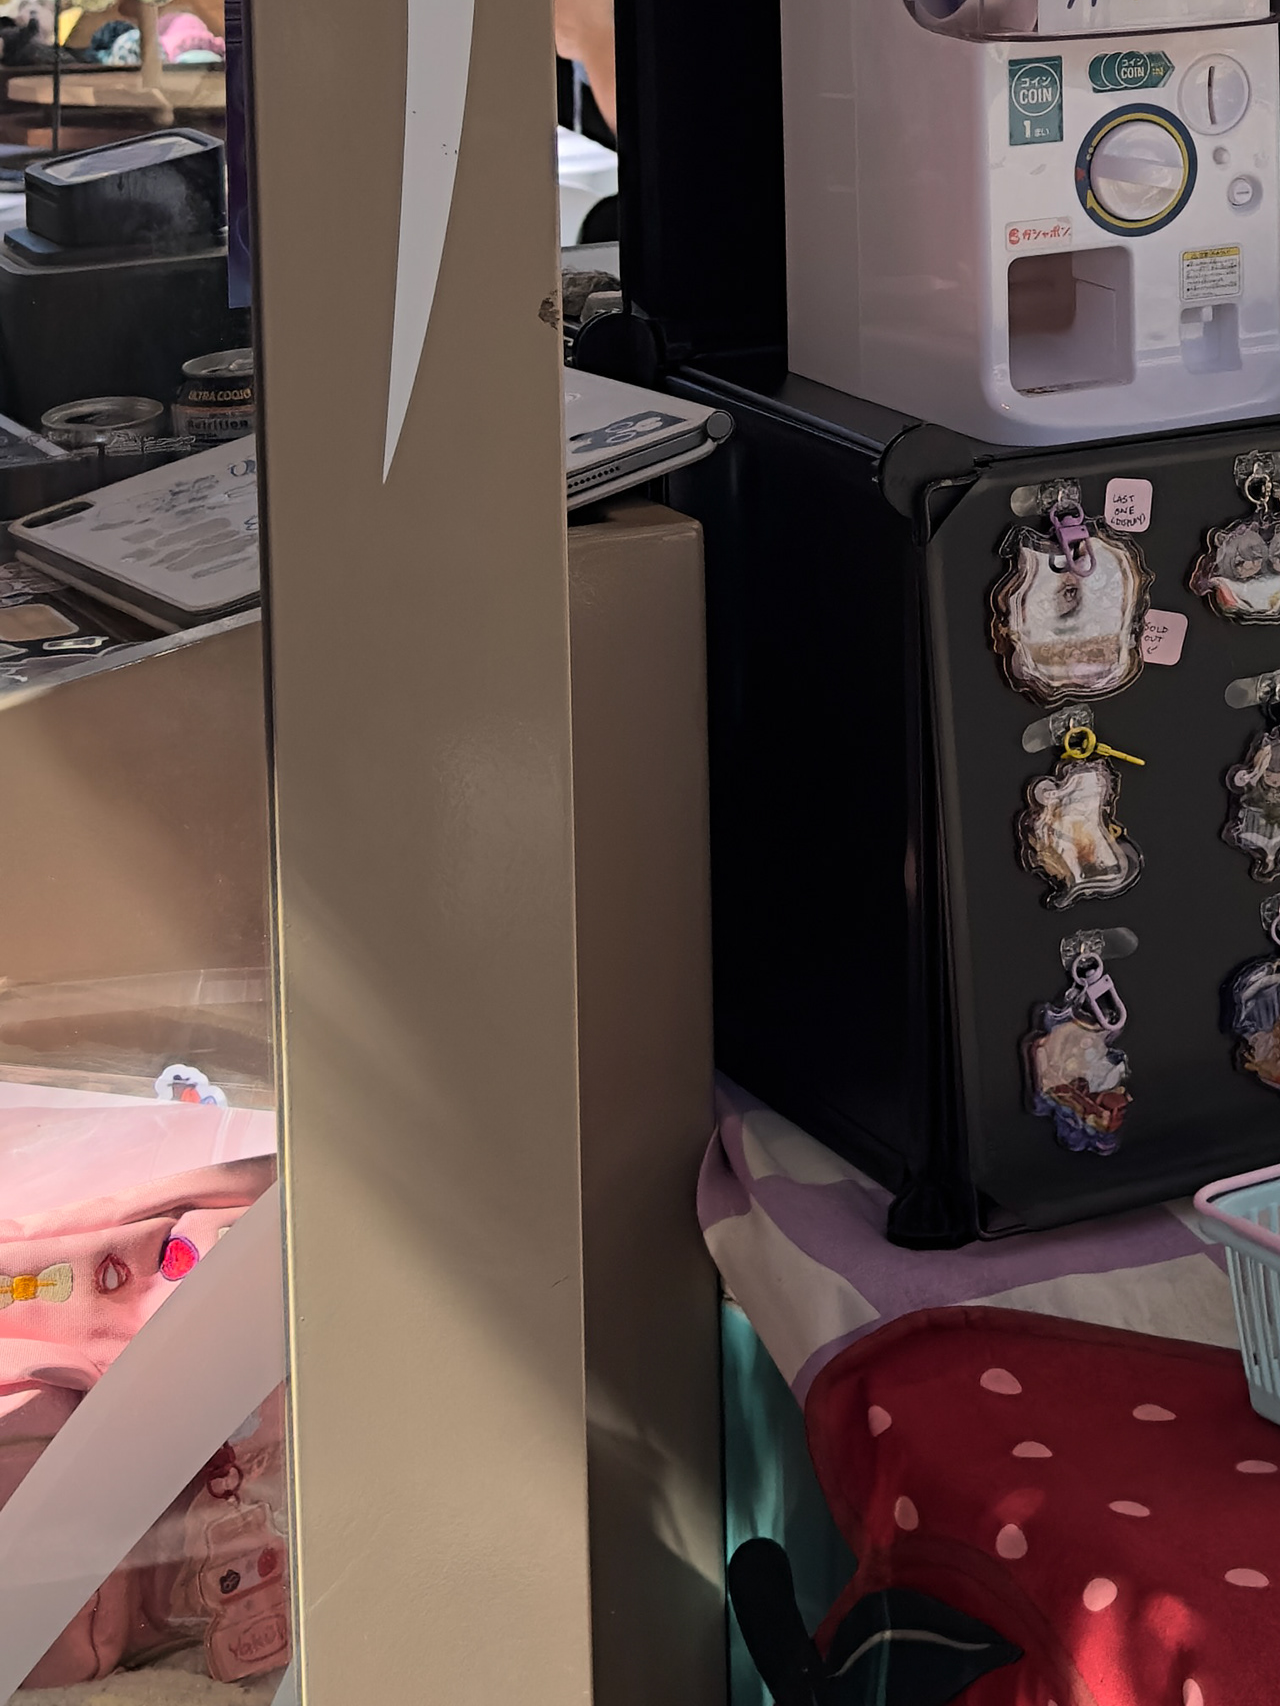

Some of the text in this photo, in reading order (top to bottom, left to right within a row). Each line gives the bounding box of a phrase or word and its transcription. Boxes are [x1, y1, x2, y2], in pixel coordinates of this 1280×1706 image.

[1121, 57, 1144, 67] コイン
[1121, 66, 1146, 79] COIN
[1020, 76, 1051, 88] コイン
[1019, 88, 1053, 105] COIN
[1113, 494, 1135, 504] LAST
[1114, 505, 1135, 515] ONE
[1145, 621, 1169, 634] SOLD
[1144, 635, 1164, 644] OUT
